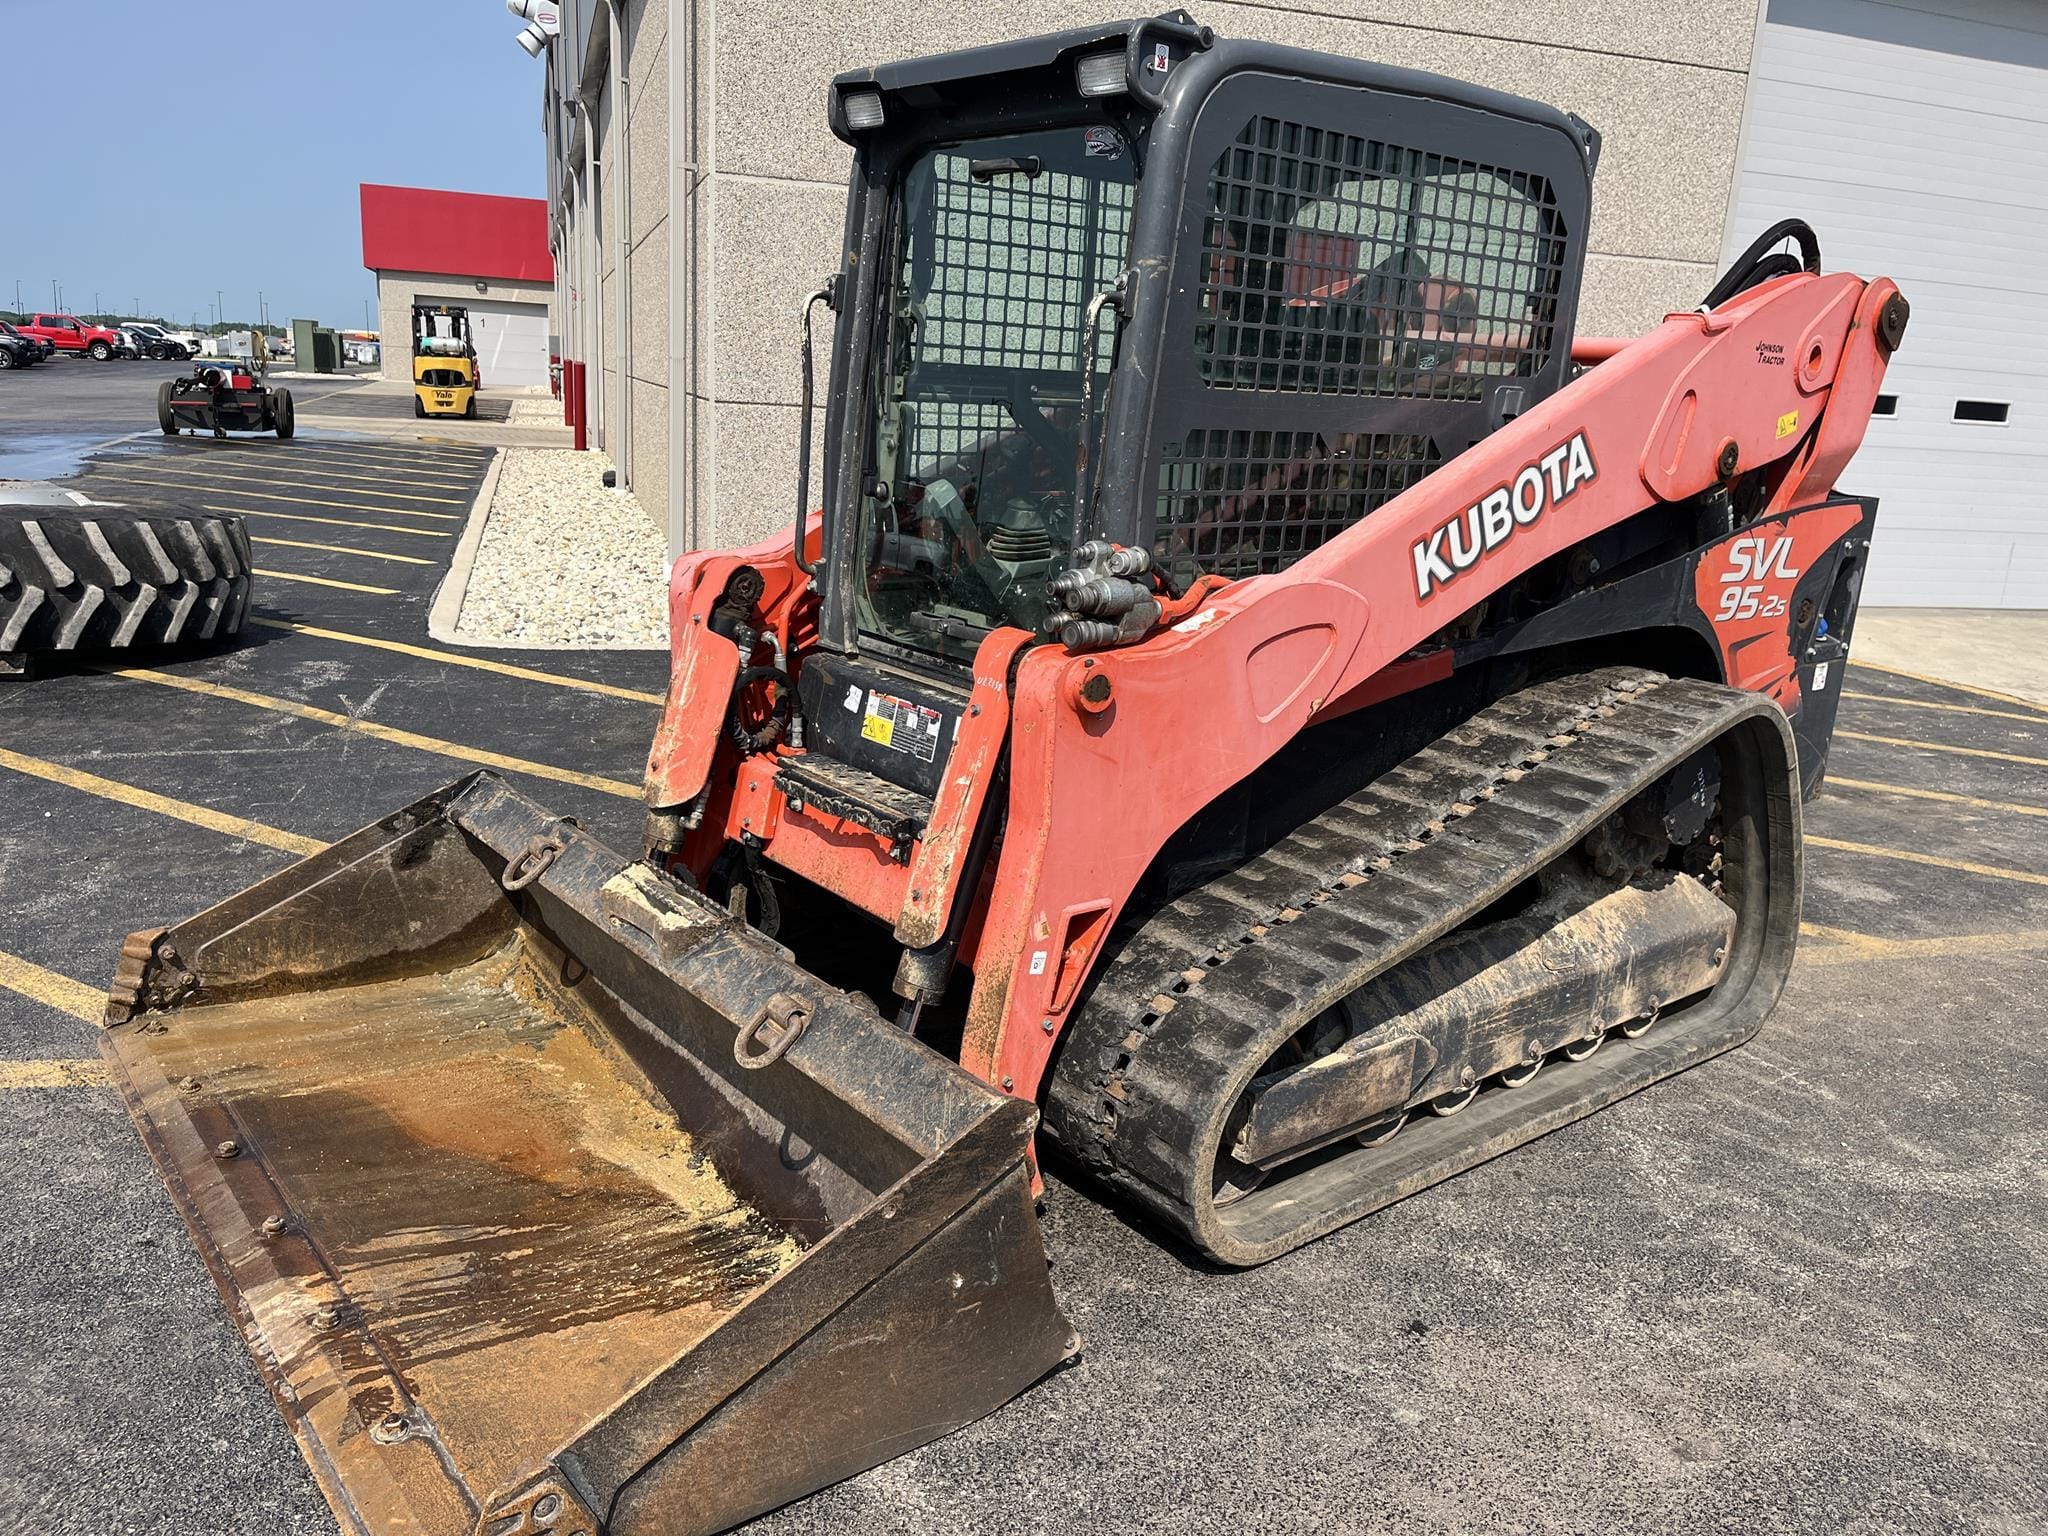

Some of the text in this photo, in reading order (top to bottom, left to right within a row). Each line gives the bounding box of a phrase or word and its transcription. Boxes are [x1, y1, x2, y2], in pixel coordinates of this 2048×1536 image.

[481, 318, 485, 328] 1
[436, 391, 453, 399] Yale
[1412, 433, 1596, 599] KUBOTA
[1719, 536, 1800, 583] SVL
